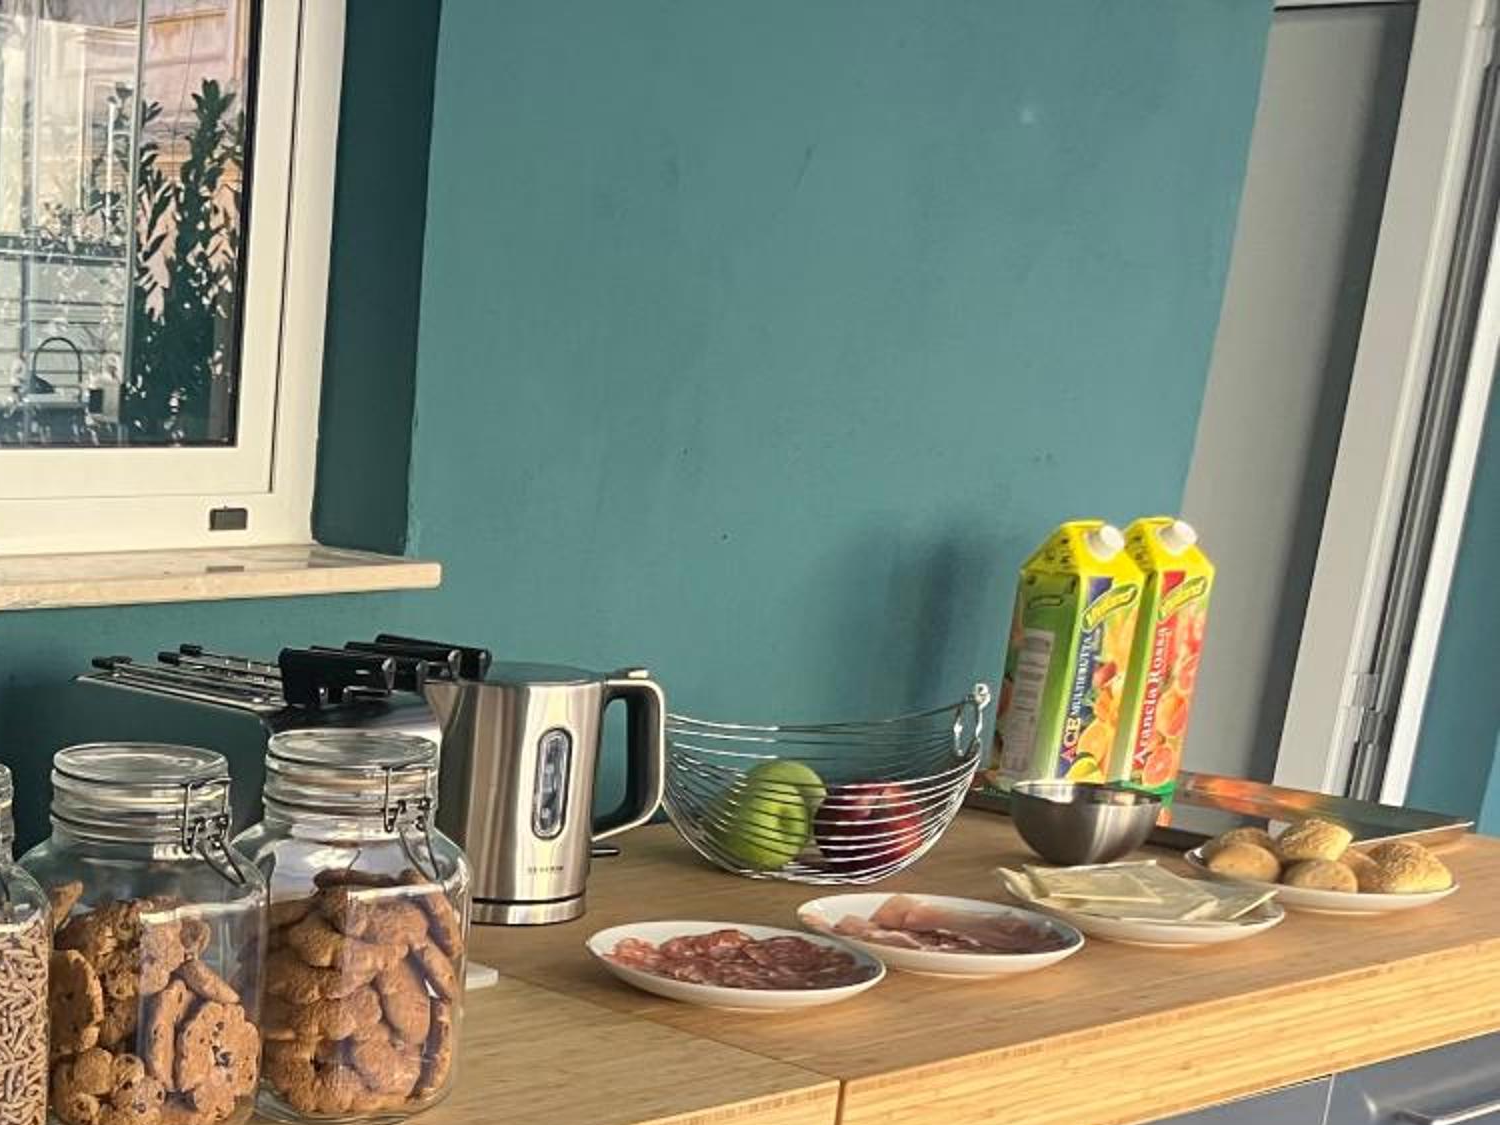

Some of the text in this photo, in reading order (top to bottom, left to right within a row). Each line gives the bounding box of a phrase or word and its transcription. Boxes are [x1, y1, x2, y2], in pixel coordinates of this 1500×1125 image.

[1060, 717, 1081, 763] ACE
[1133, 627, 1171, 766] Arancia Rossa
